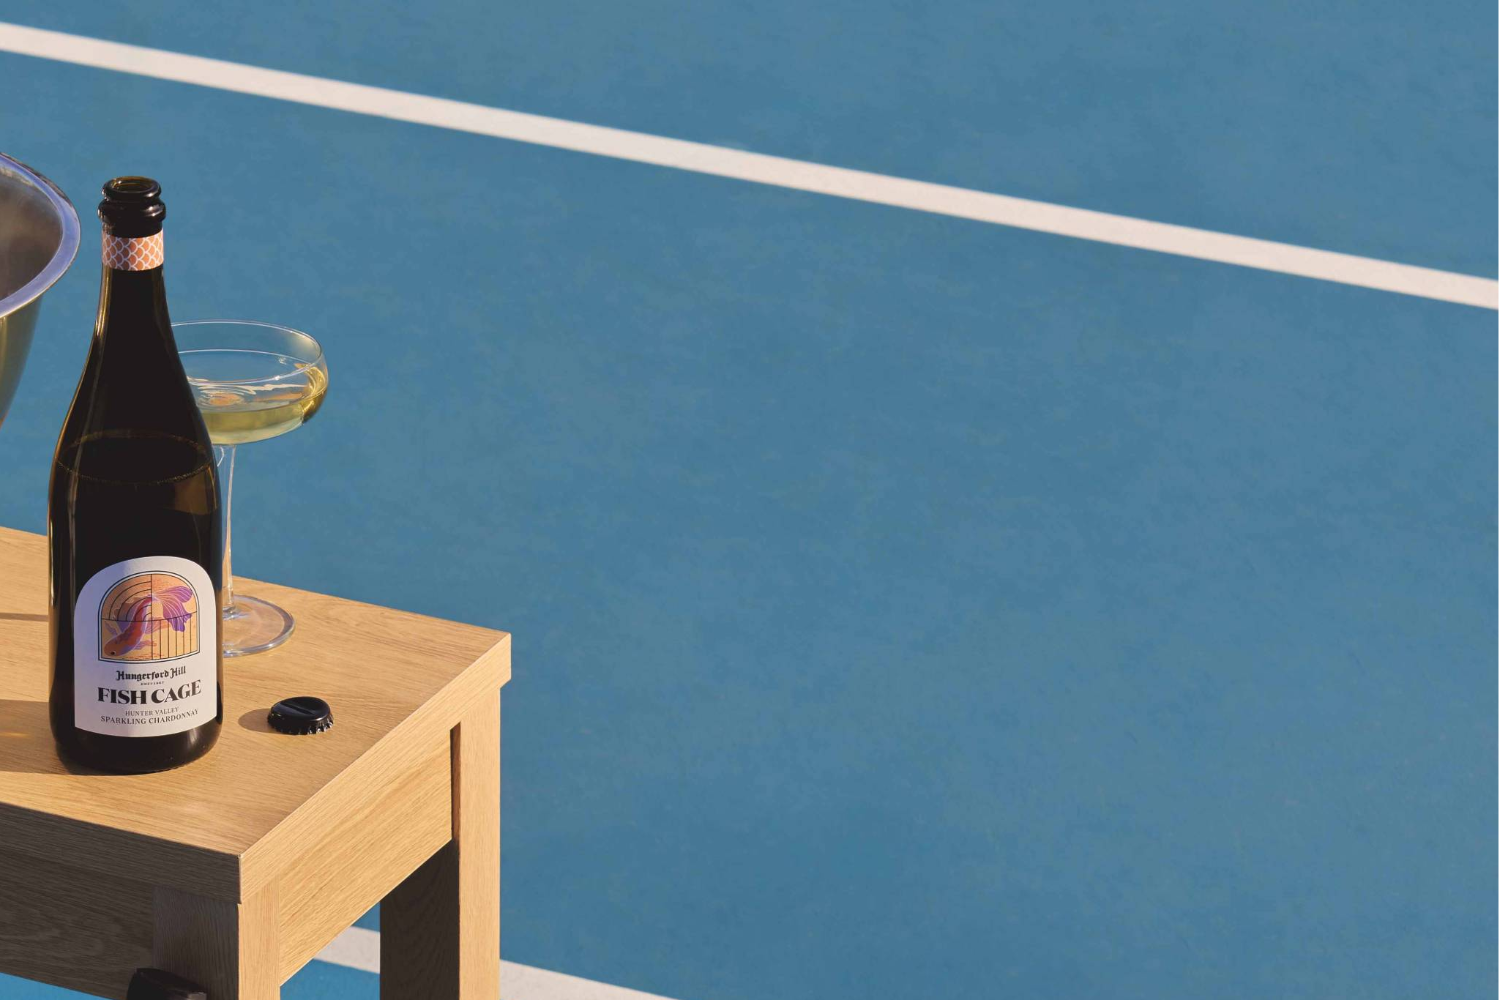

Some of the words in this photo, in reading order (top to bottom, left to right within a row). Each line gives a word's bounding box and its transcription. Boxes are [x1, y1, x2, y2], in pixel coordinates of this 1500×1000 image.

[116, 670, 169, 681] Hungerford
[170, 666, 186, 678] Hill
[98, 687, 147, 704] FISH
[151, 680, 201, 703] CAGE
[101, 716, 146, 724] SPARKLING
[149, 709, 199, 724] CHARDONNAY
[155, 707, 179, 715] VALLEY
